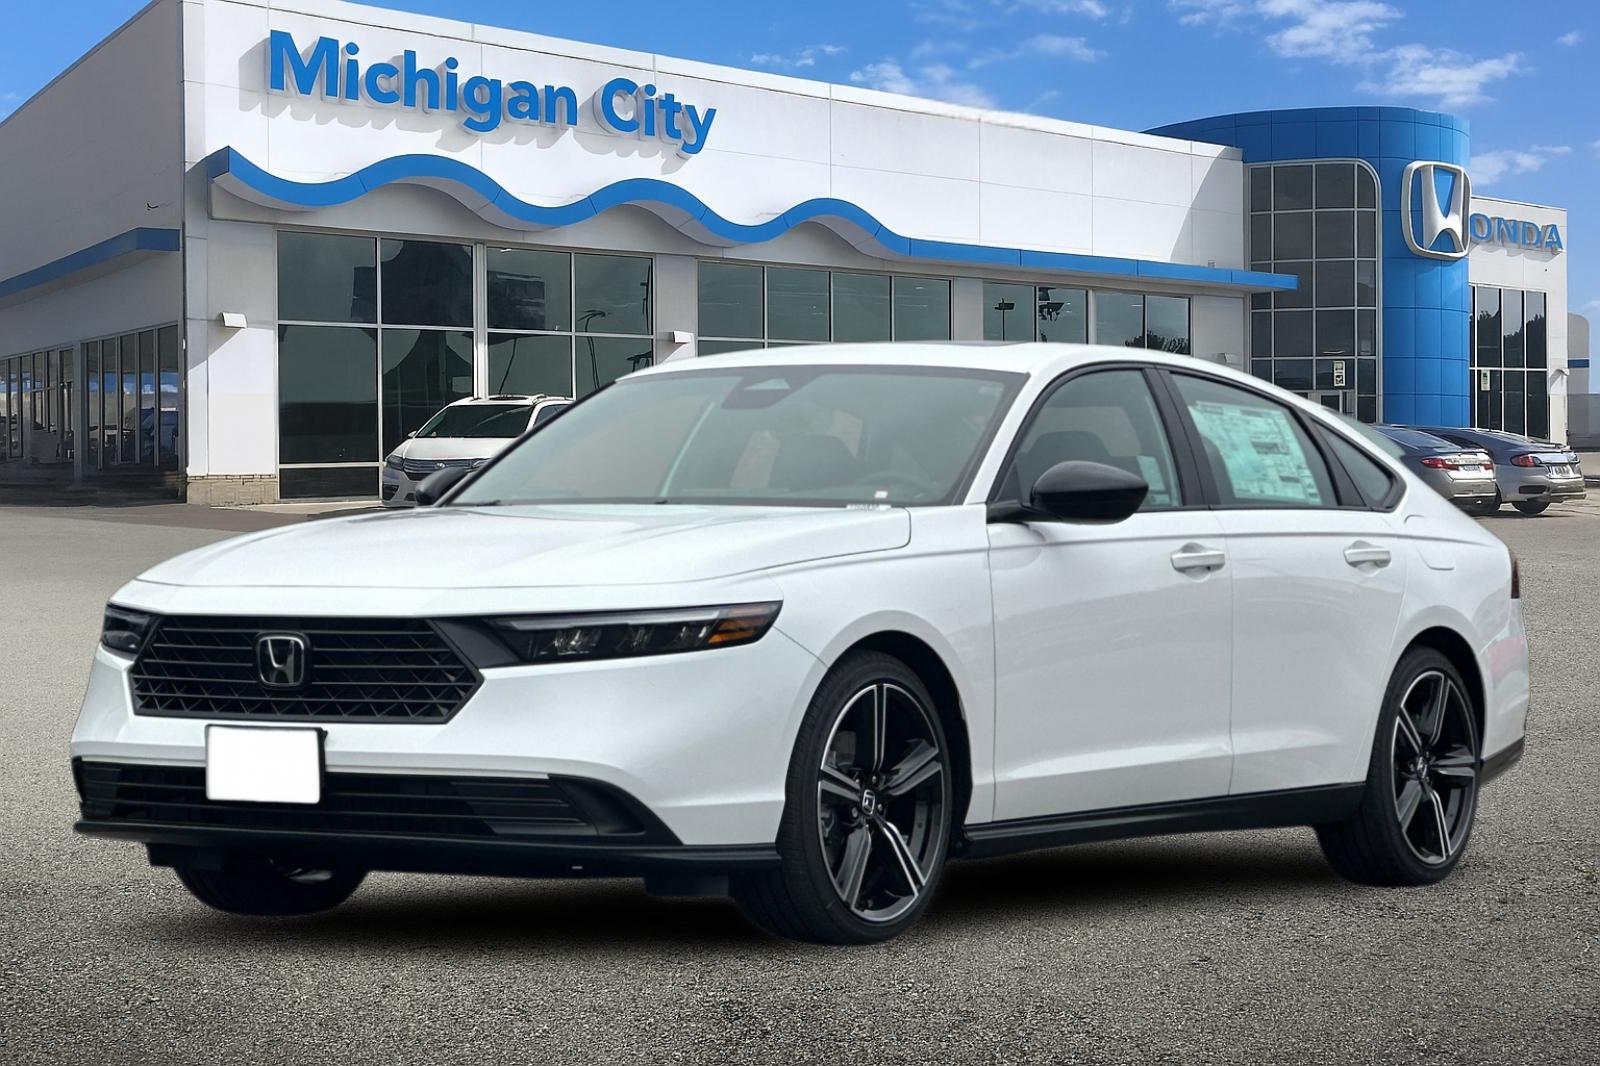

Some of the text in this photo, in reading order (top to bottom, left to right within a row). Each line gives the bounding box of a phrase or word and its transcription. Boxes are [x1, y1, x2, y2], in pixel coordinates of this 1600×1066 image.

[270, 29, 717, 155] Michigan City
[1469, 212, 1564, 250] ONDA
